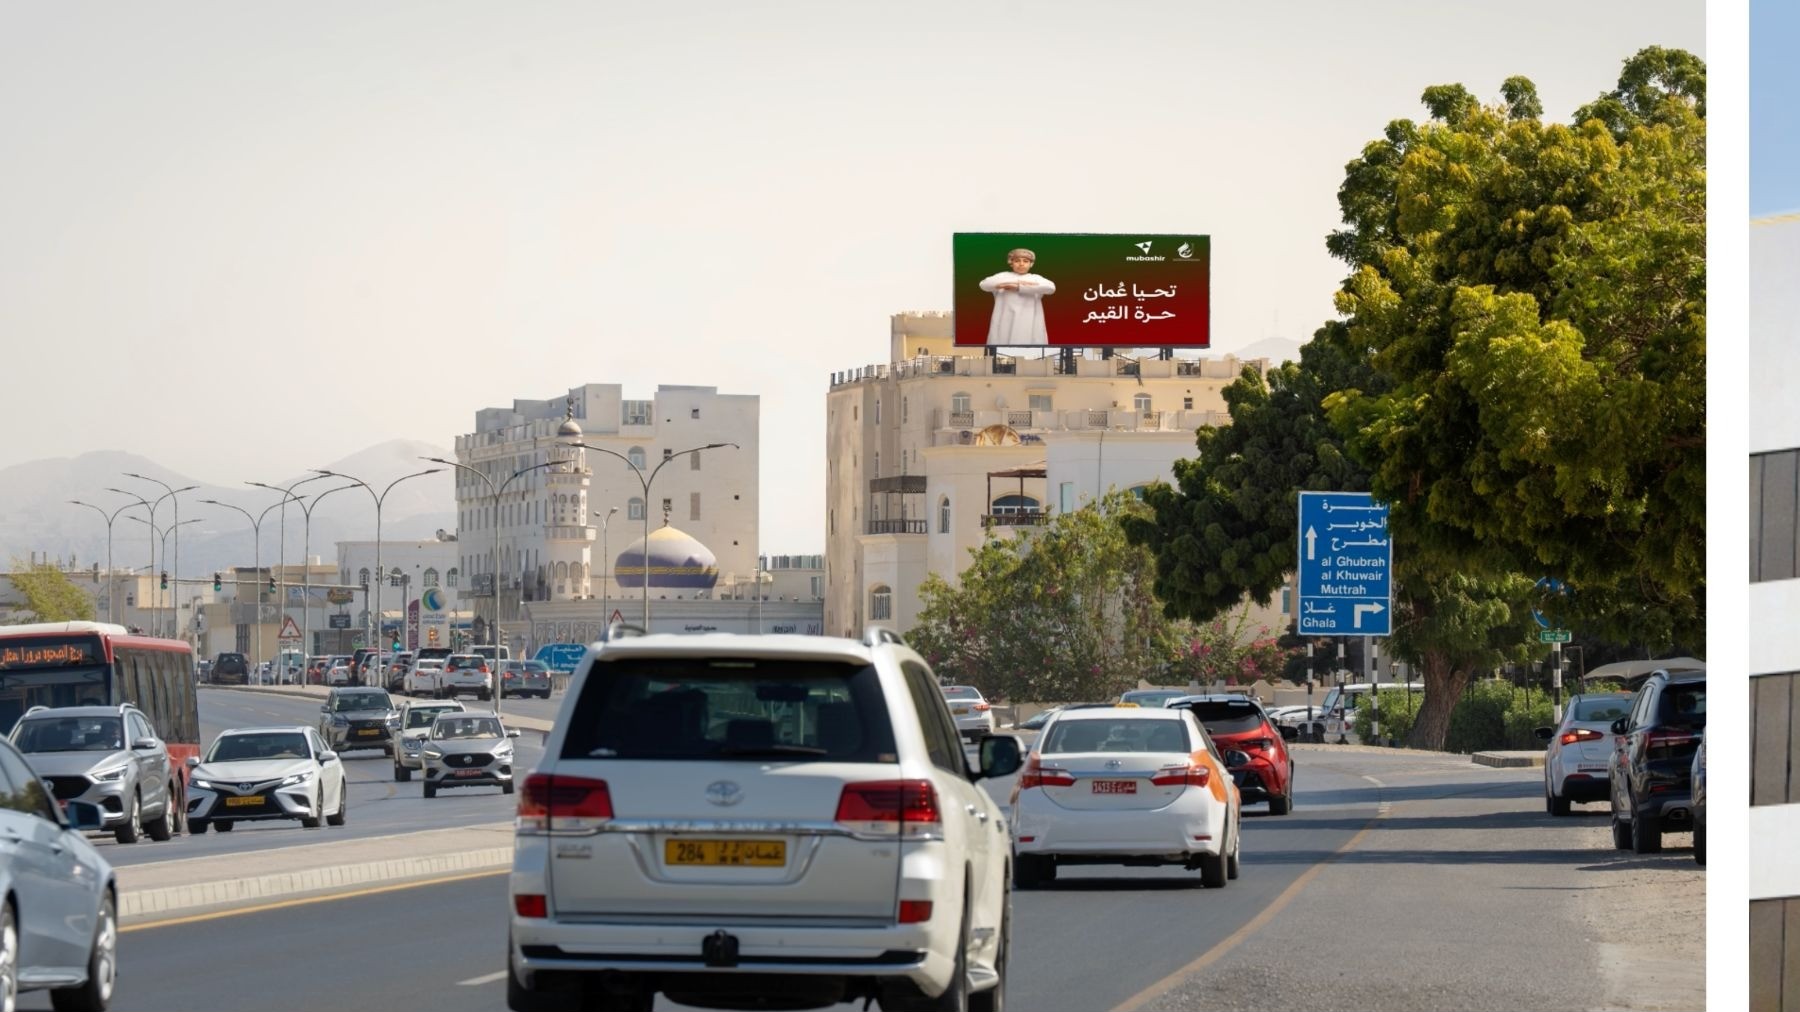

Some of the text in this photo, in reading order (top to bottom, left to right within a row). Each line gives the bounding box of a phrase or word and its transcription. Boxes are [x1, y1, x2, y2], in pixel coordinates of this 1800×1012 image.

[1132, 282, 1177, 301] تحيا
[1082, 304, 1176, 323] حرة القيم
[1326, 516, 1387, 532] الخوير
[1331, 533, 1387, 551] مطرح
[1321, 555, 1385, 566] al Ghubrah
[1321, 570, 1383, 580] al Khuwair
[1320, 584, 1366, 594] Muttrah
[1303, 600, 1336, 613] غلا
[1302, 616, 1336, 627] Ghala
[677, 842, 704, 860] 284
